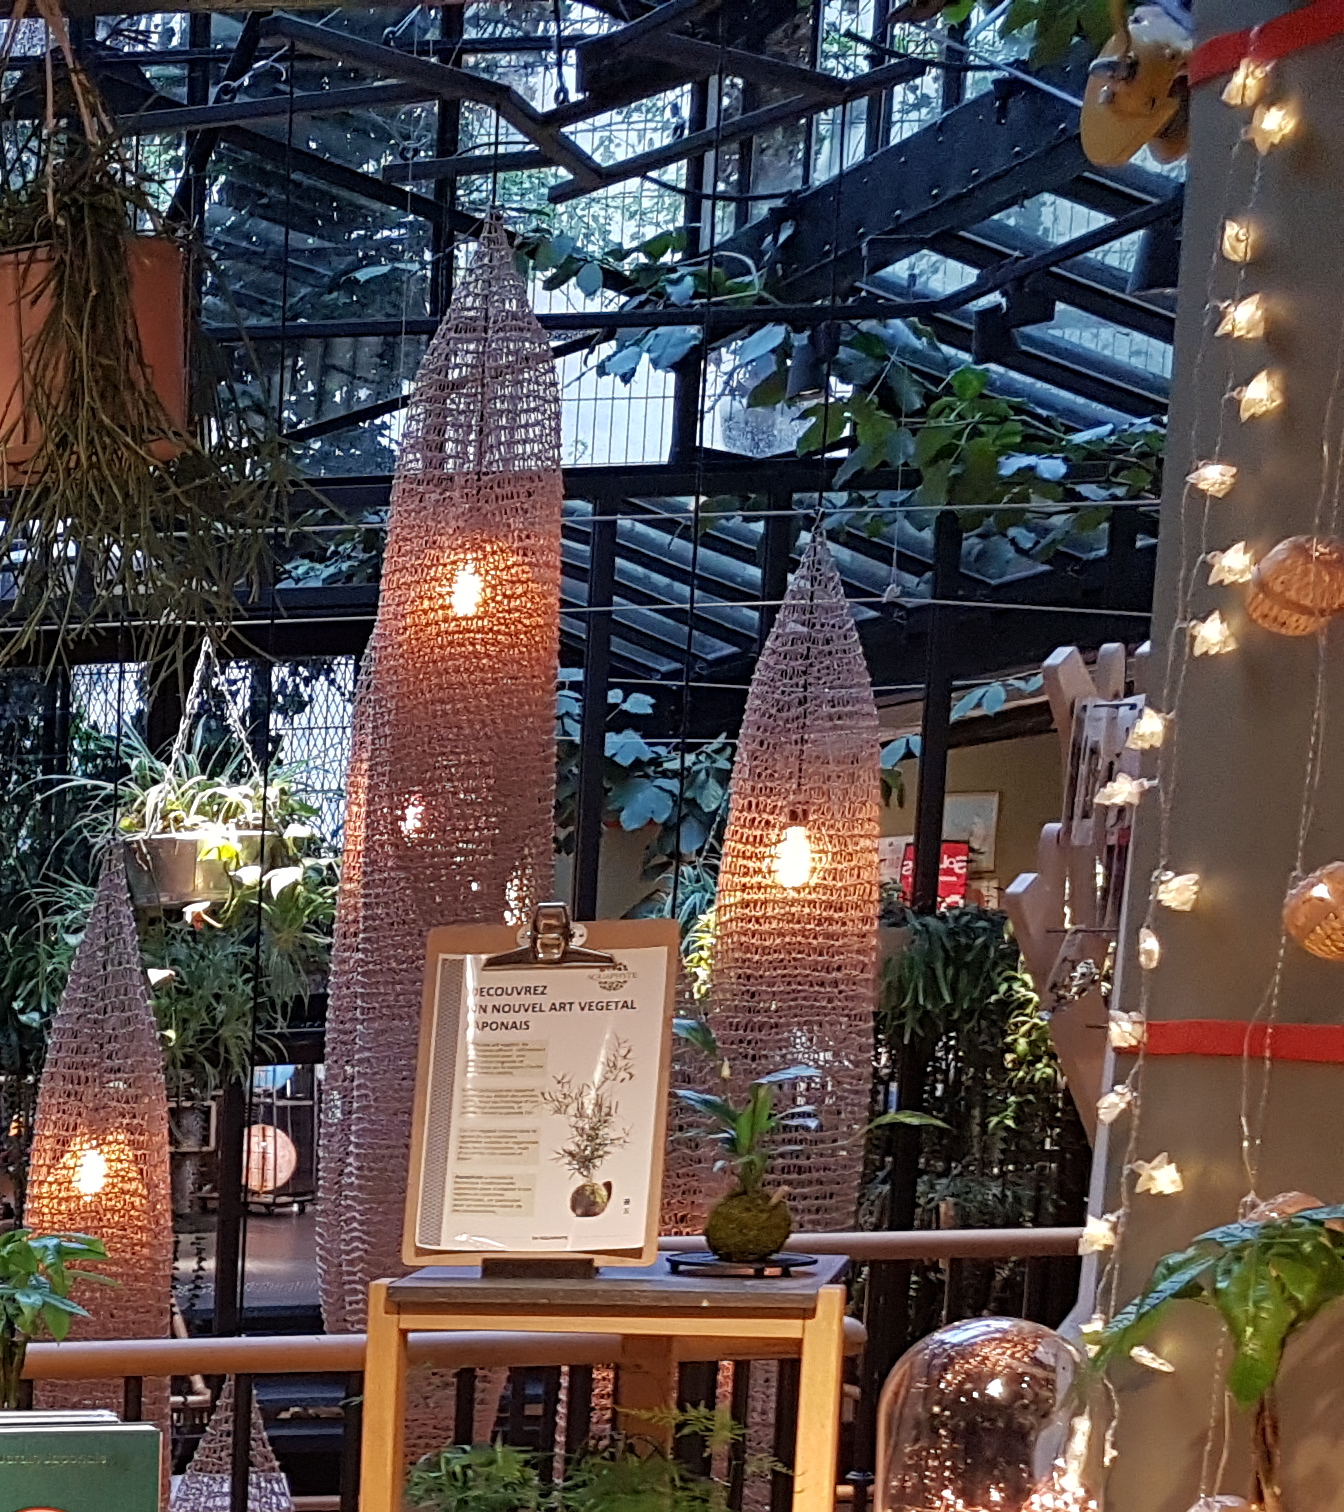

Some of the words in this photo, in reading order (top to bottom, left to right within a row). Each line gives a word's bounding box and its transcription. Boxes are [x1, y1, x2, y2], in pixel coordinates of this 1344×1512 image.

[491, 1002, 546, 1014] NOUVEL
[548, 1001, 575, 1012] ART
[578, 999, 638, 1012] VEGETAL
